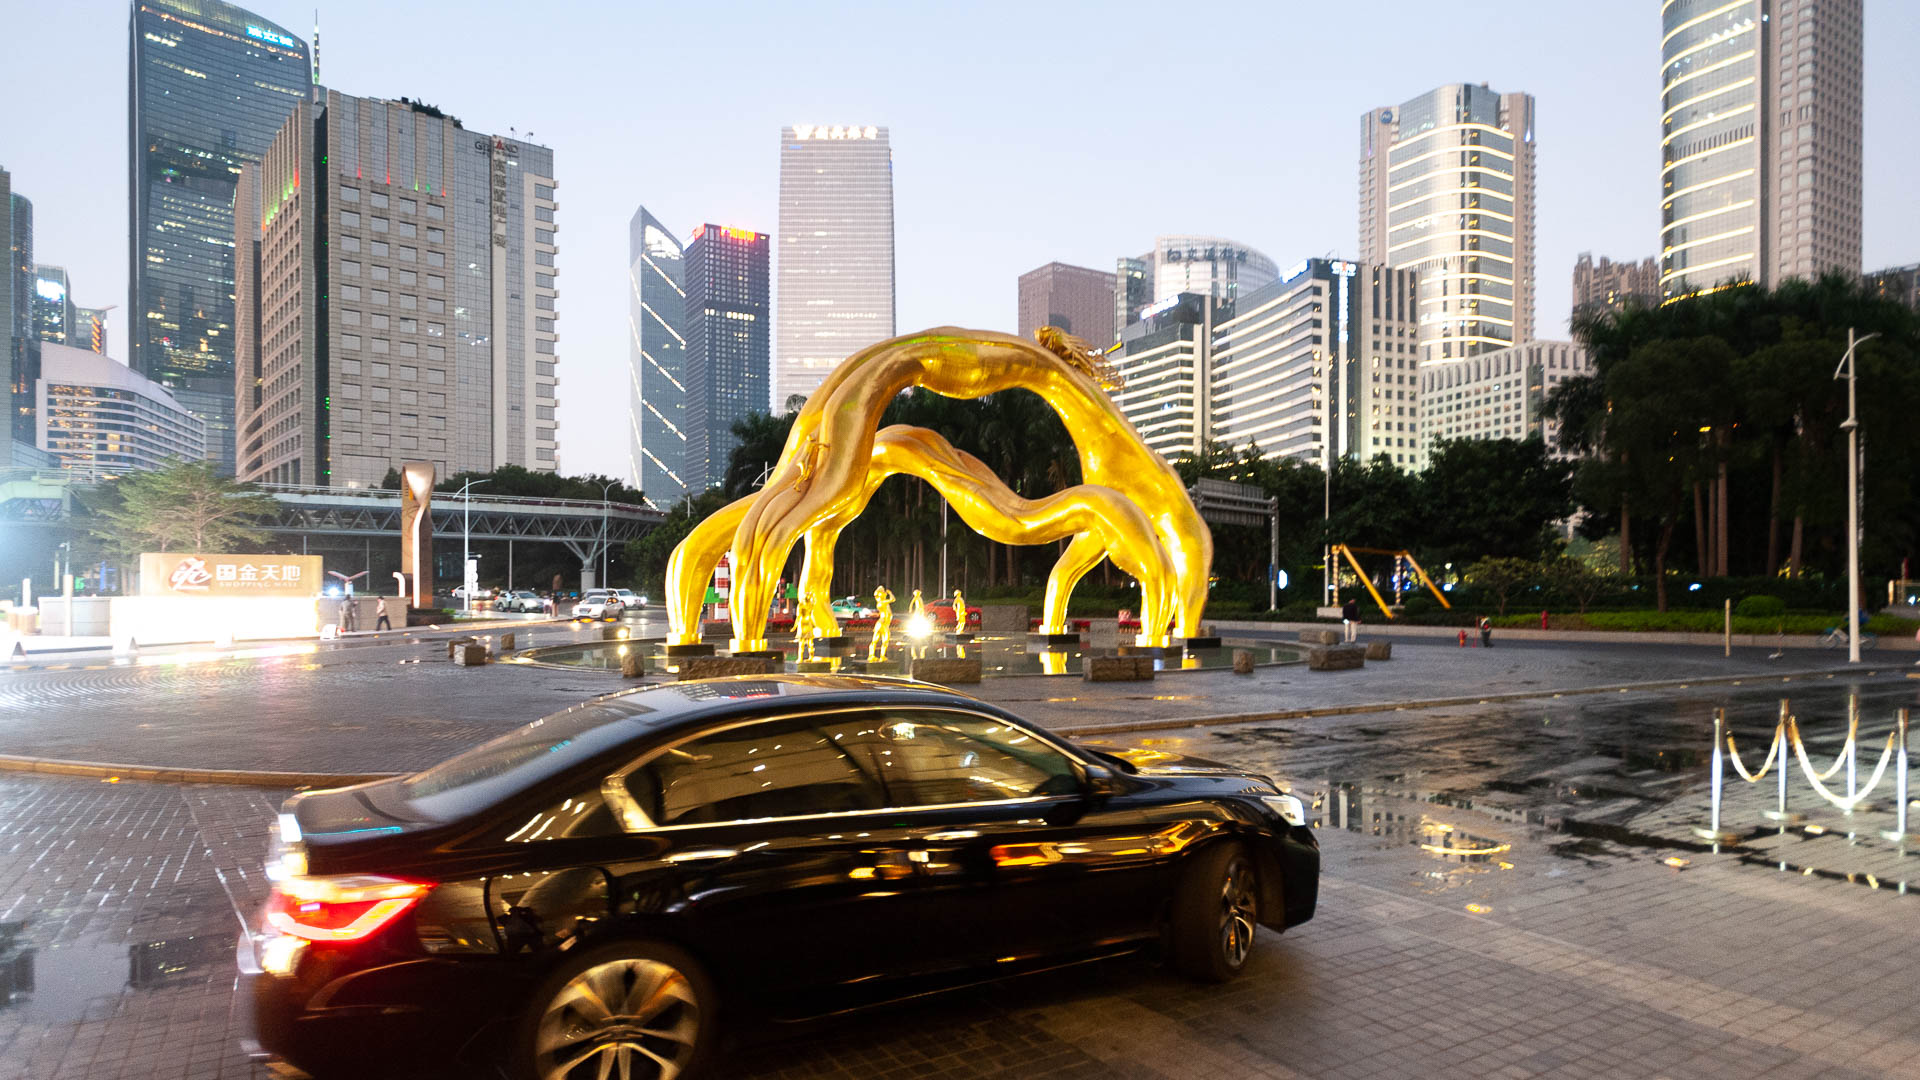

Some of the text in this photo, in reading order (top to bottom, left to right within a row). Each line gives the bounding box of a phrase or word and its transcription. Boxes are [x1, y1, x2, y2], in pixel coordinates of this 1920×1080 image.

[170, 558, 213, 591] ifc
[216, 564, 301, 582] 国金天地
